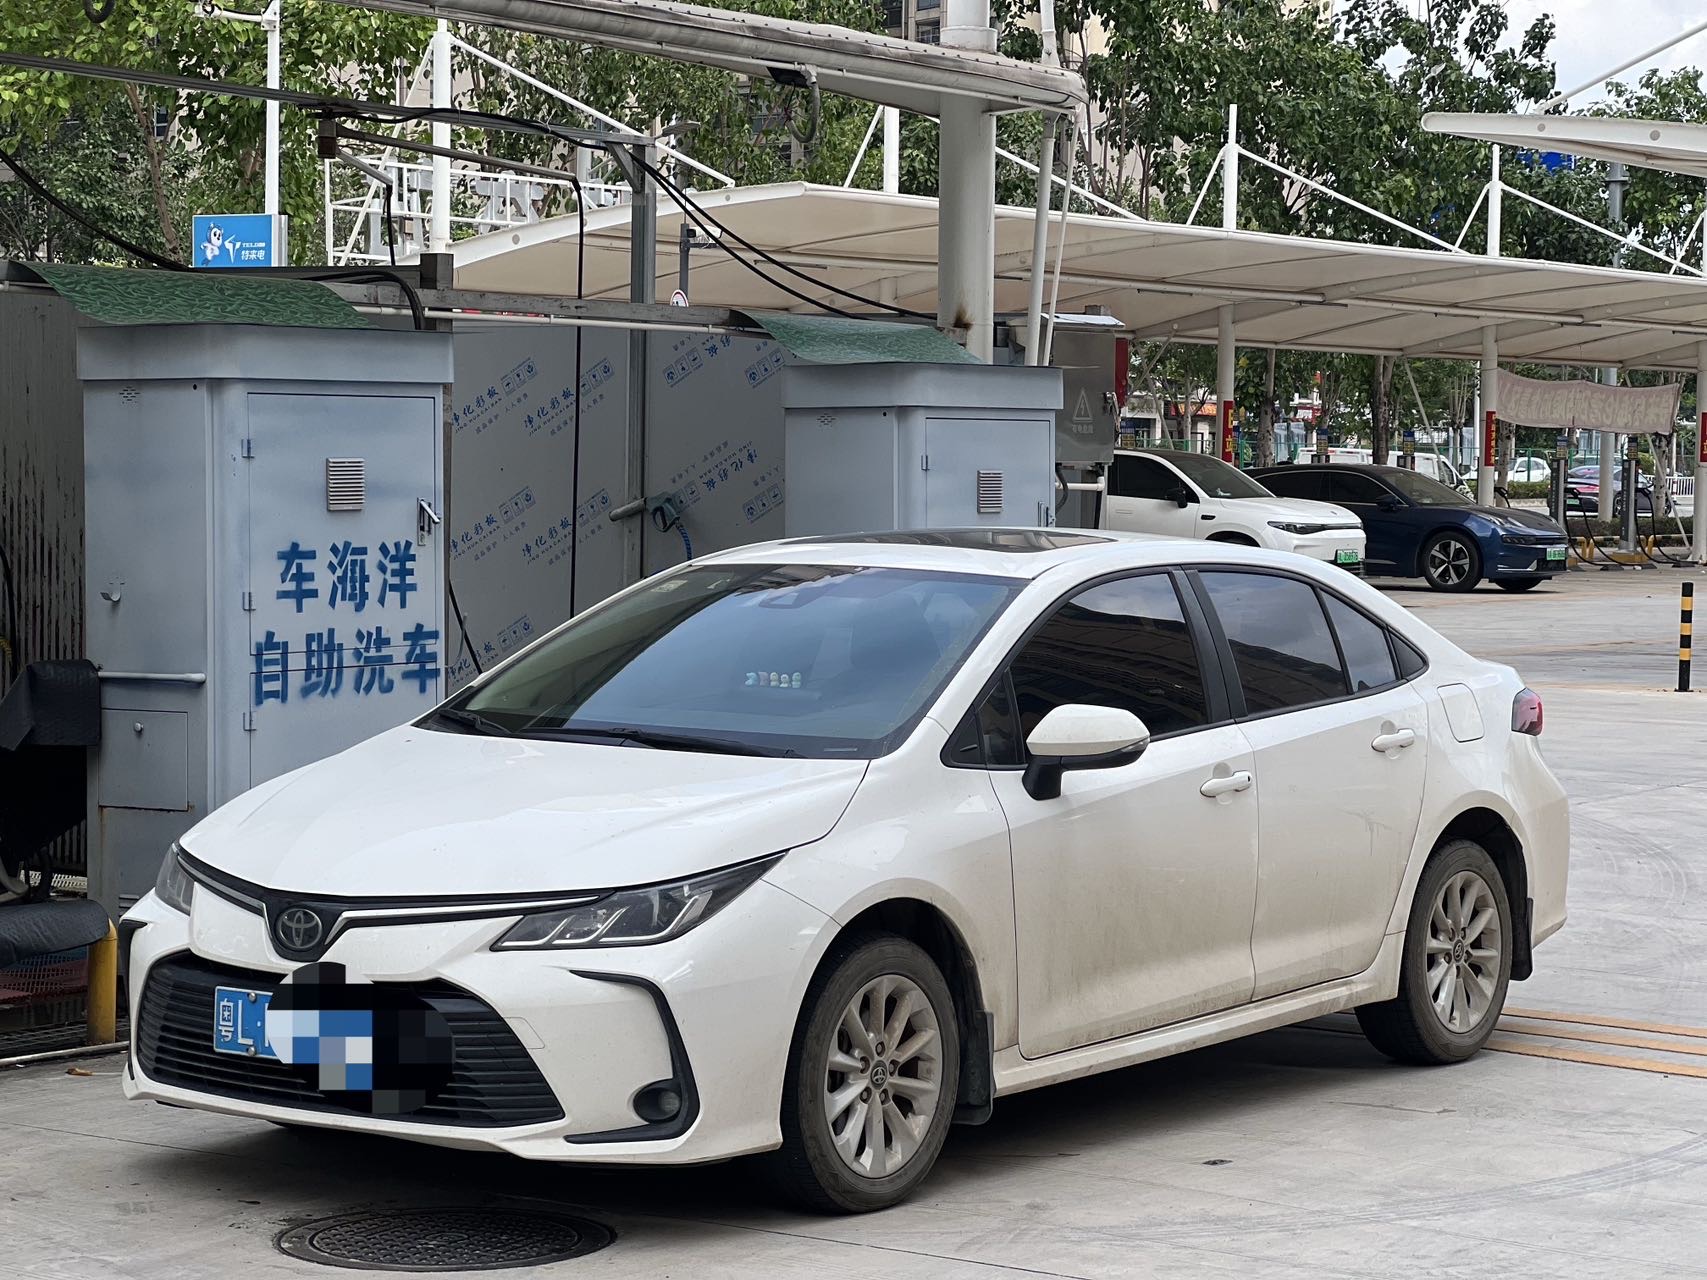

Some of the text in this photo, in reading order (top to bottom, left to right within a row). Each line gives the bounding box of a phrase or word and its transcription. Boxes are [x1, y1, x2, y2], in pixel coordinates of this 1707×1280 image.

[241, 249, 265, 260] 特来电
[276, 540, 417, 613] 车海洋
[255, 623, 440, 707] 自助洗车
